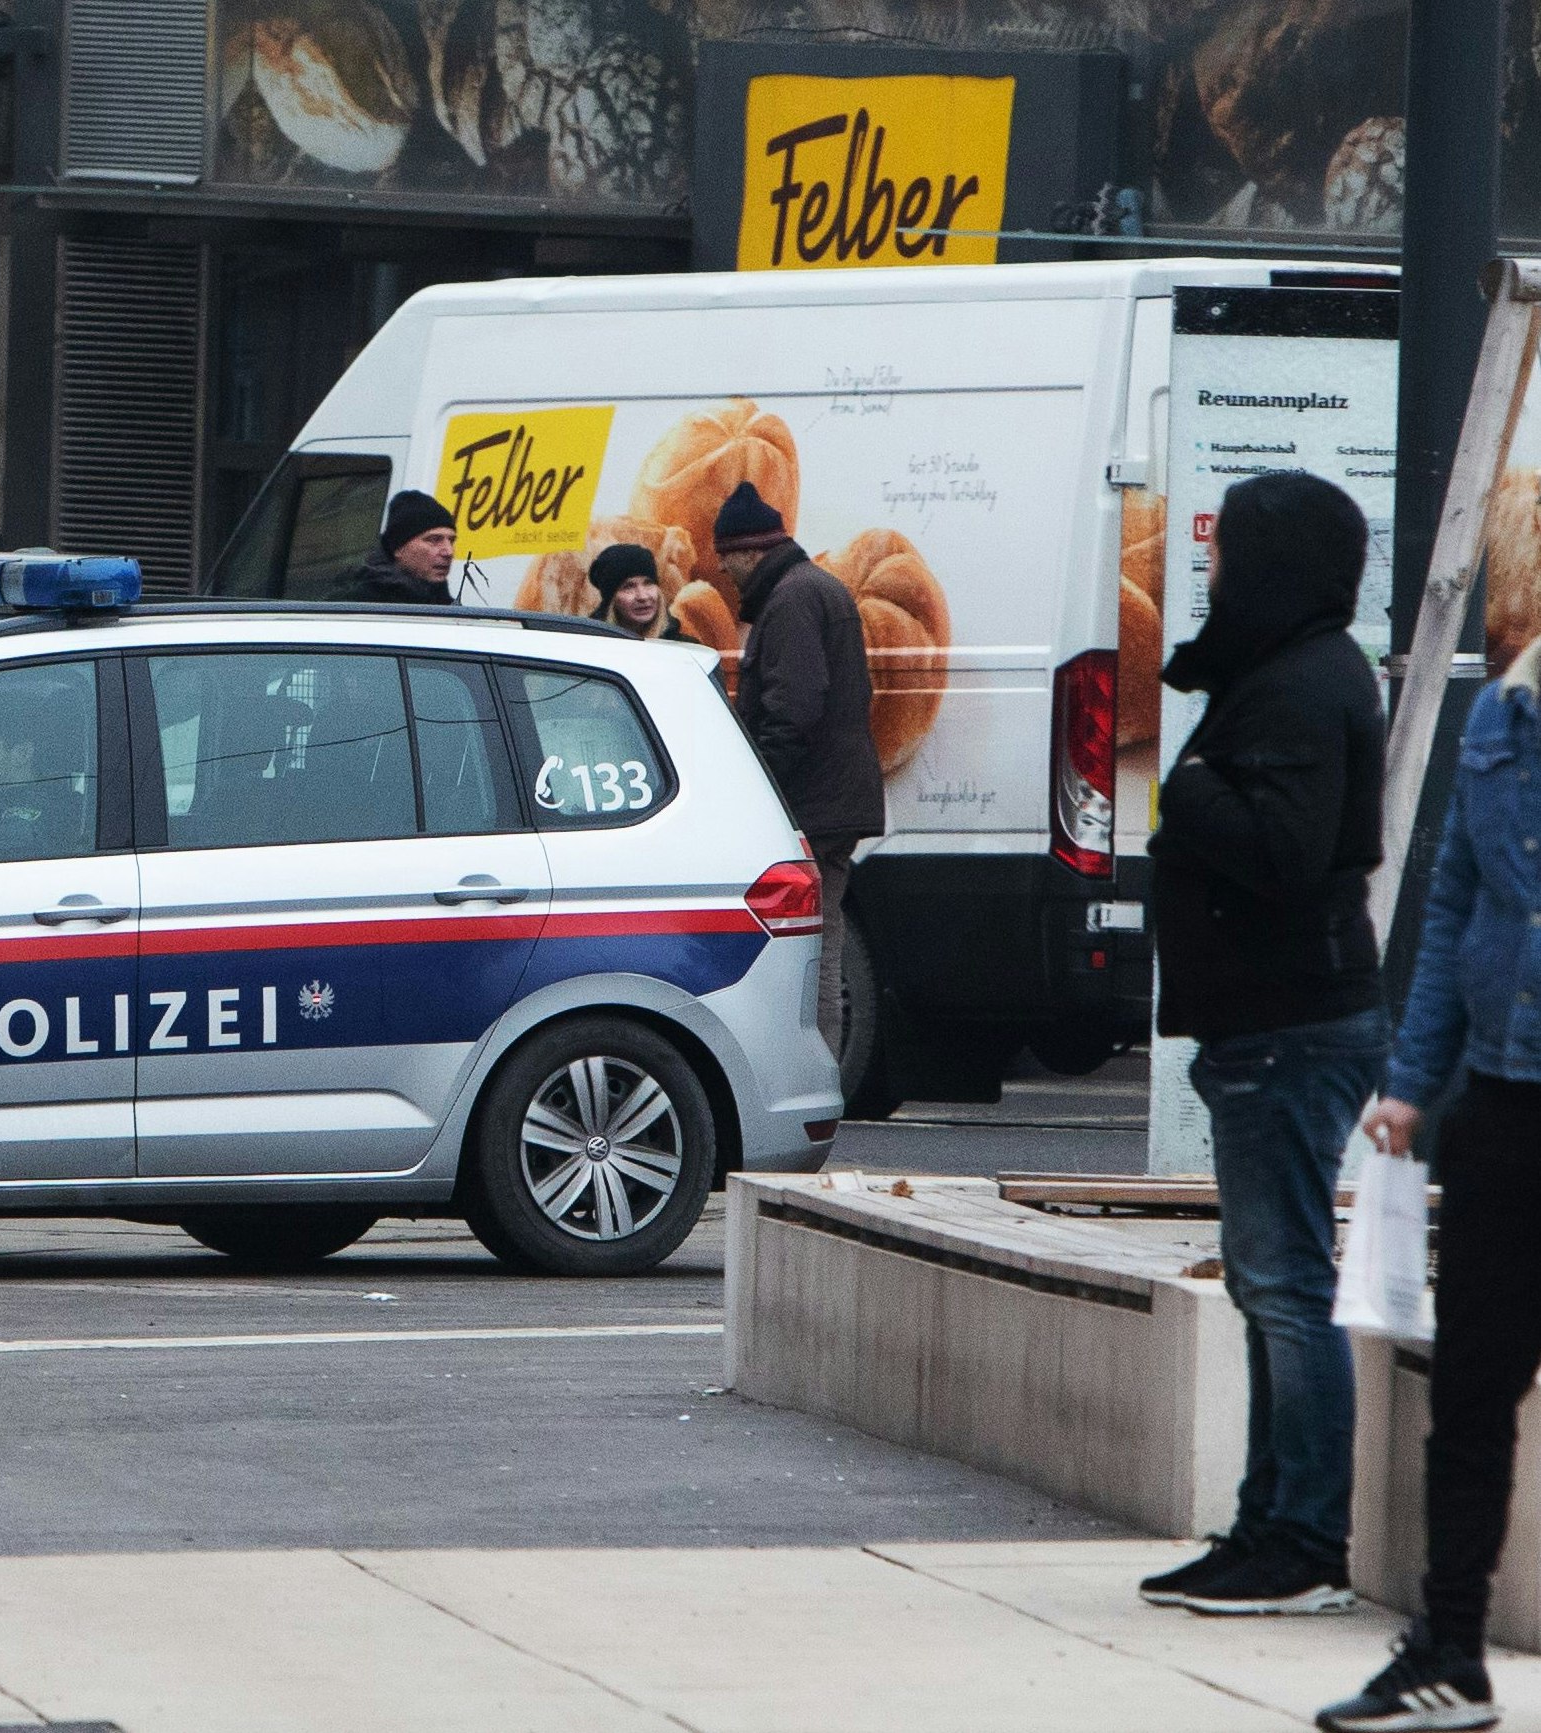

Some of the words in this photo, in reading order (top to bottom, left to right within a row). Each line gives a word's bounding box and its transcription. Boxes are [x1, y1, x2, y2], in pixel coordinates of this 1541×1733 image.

[765, 106, 980, 267] Felber
[1197, 389, 1350, 413] Reumannplatz
[1210, 441, 1297, 456] Hauptbahnhof
[452, 424, 585, 531] Felber
[570, 760, 653, 812] 133
